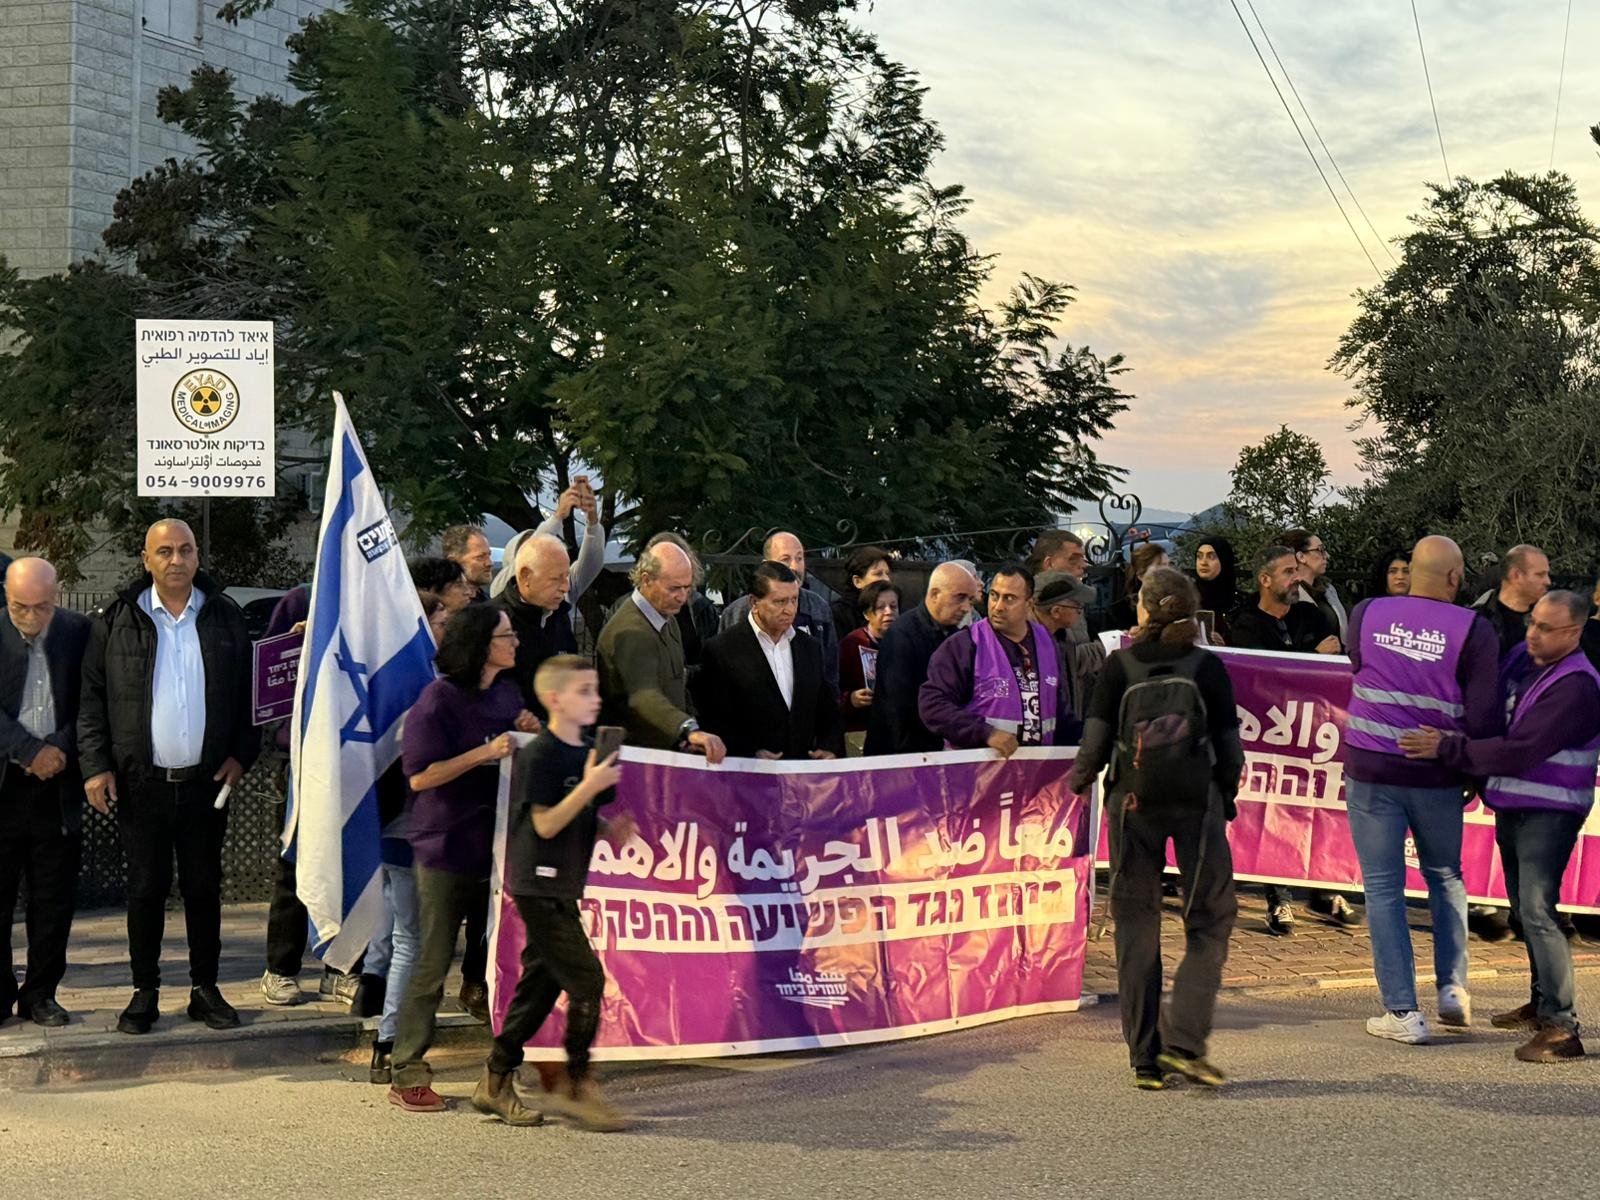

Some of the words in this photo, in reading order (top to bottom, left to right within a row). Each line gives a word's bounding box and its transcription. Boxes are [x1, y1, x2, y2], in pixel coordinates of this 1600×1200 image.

[141, 330, 184, 341] רפואית
[188, 329, 234, 342] להדמיה
[239, 331, 269, 343] איאד
[142, 347, 182, 367] الطبي
[185, 348, 240, 365] للتصوير
[245, 349, 269, 365] إياد
[183, 374, 227, 392] EYAD
[176, 391, 204, 429] MEDICAL
[207, 392, 235, 429] IMAGING
[146, 438, 220, 450] אולטרסאונד
[223, 439, 265, 452] בדיקות
[215, 456, 262, 470] فحوصات
[145, 475, 266, 488] 054-9009976
[1373, 632, 1402, 645] ביחד
[1416, 628, 1446, 645] نقف
[1403, 639, 1446, 654] עומדים
[1236, 700, 1340, 764] والاه
[1239, 760, 1328, 800] והה
[917, 818, 986, 869] ضد
[588, 821, 718, 900] والاهم
[728, 816, 902, 896] الجريمة
[908, 887, 965, 927] נגד
[973, 881, 1063, 921] ביחד
[580, 897, 720, 950] וההפקר
[724, 894, 897, 942] הפשיעה
[775, 983, 806, 996] ביחד
[806, 983, 848, 996] עומדים
